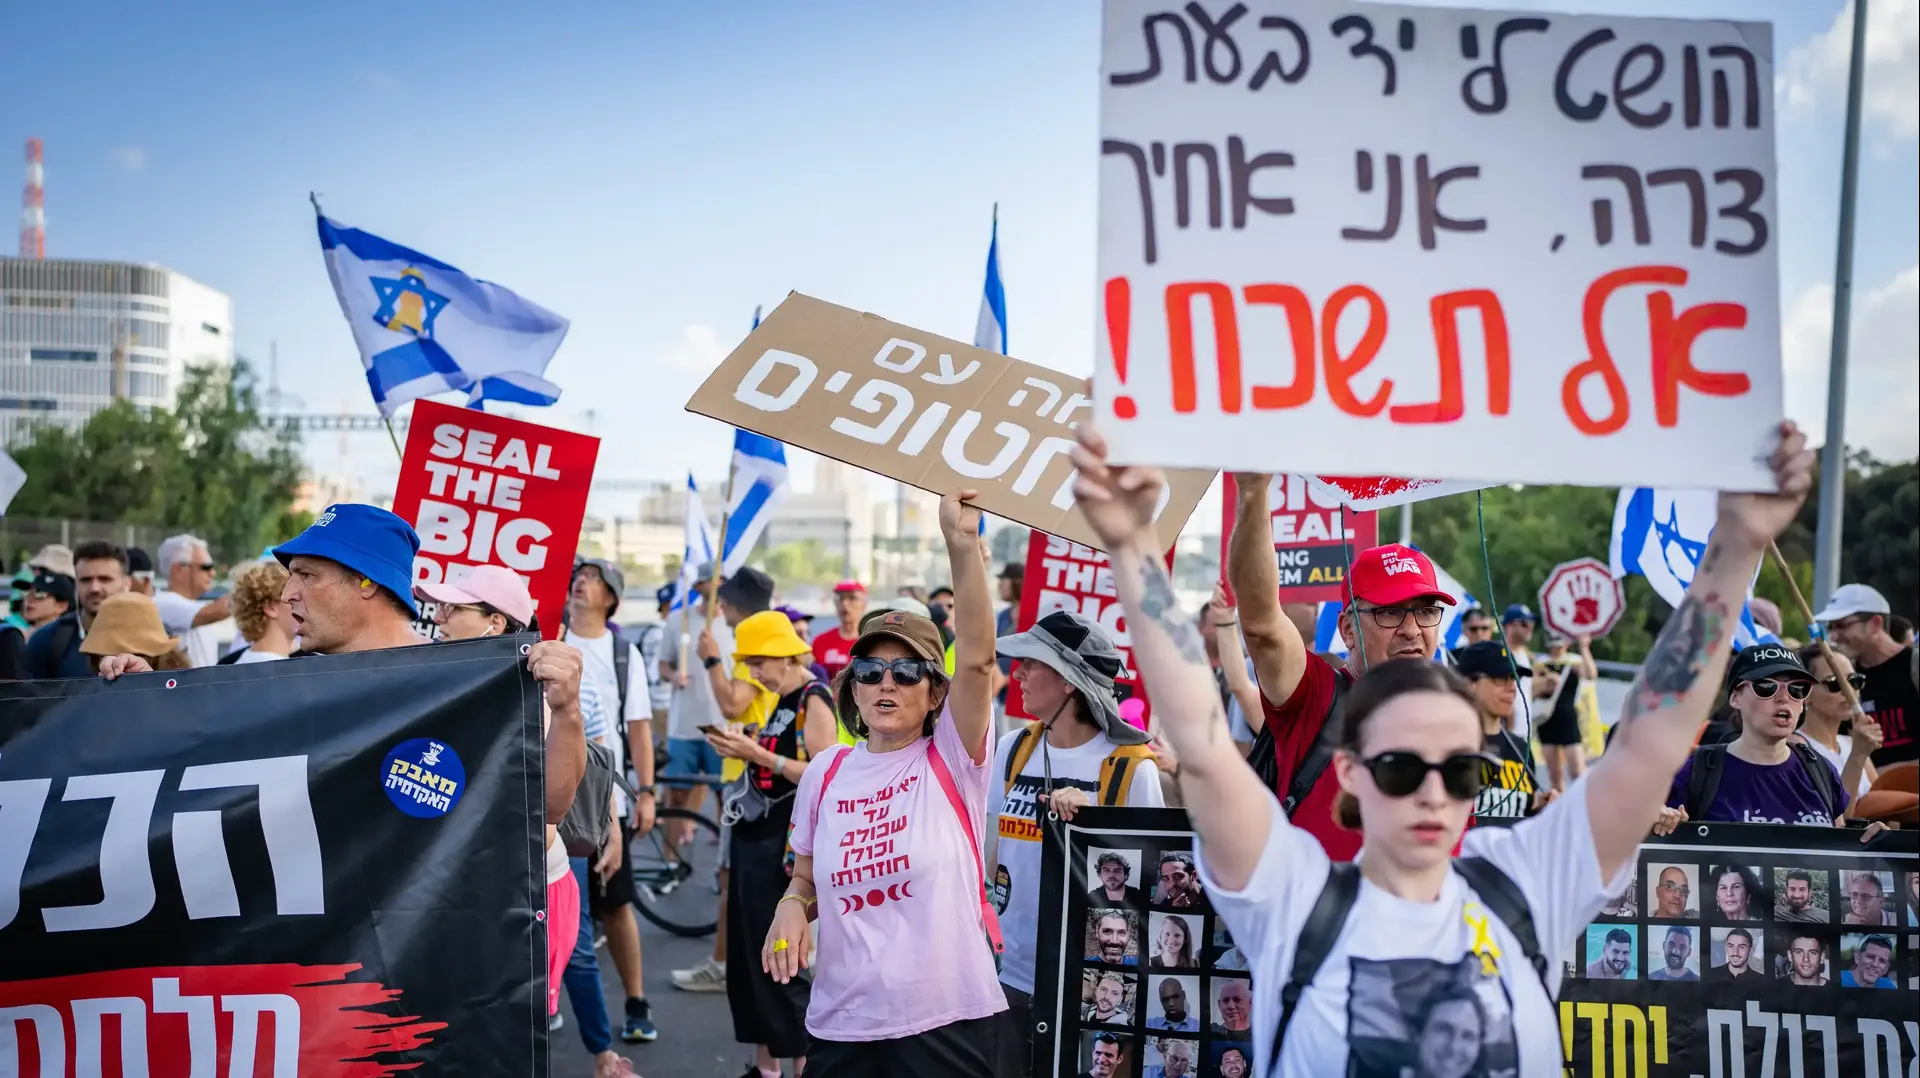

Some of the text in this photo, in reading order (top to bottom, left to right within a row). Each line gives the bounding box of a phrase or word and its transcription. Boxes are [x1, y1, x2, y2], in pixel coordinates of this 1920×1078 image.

[1108, 1, 1761, 131] הושט לי יד בעת
[1102, 133, 1296, 266] אחיך
[1340, 149, 1488, 252] אני
[873, 336, 981, 386] עם
[1104, 264, 1752, 437] אל תשכח!
[429, 423, 561, 482] SEAL
[733, 348, 1171, 524] חטופים
[424, 459, 527, 513] THE
[414, 498, 553, 572] BIG
[1271, 511, 1355, 544] EAL
[1042, 557, 1117, 597] THE
[384, 773, 451, 812] האקדמיה
[389, 758, 458, 796] מאבק
[839, 814, 907, 848] שכולם
[863, 804, 890, 824] עד
[831, 854, 910, 888] חוזרות!
[843, 838, 894, 868] וכולן
